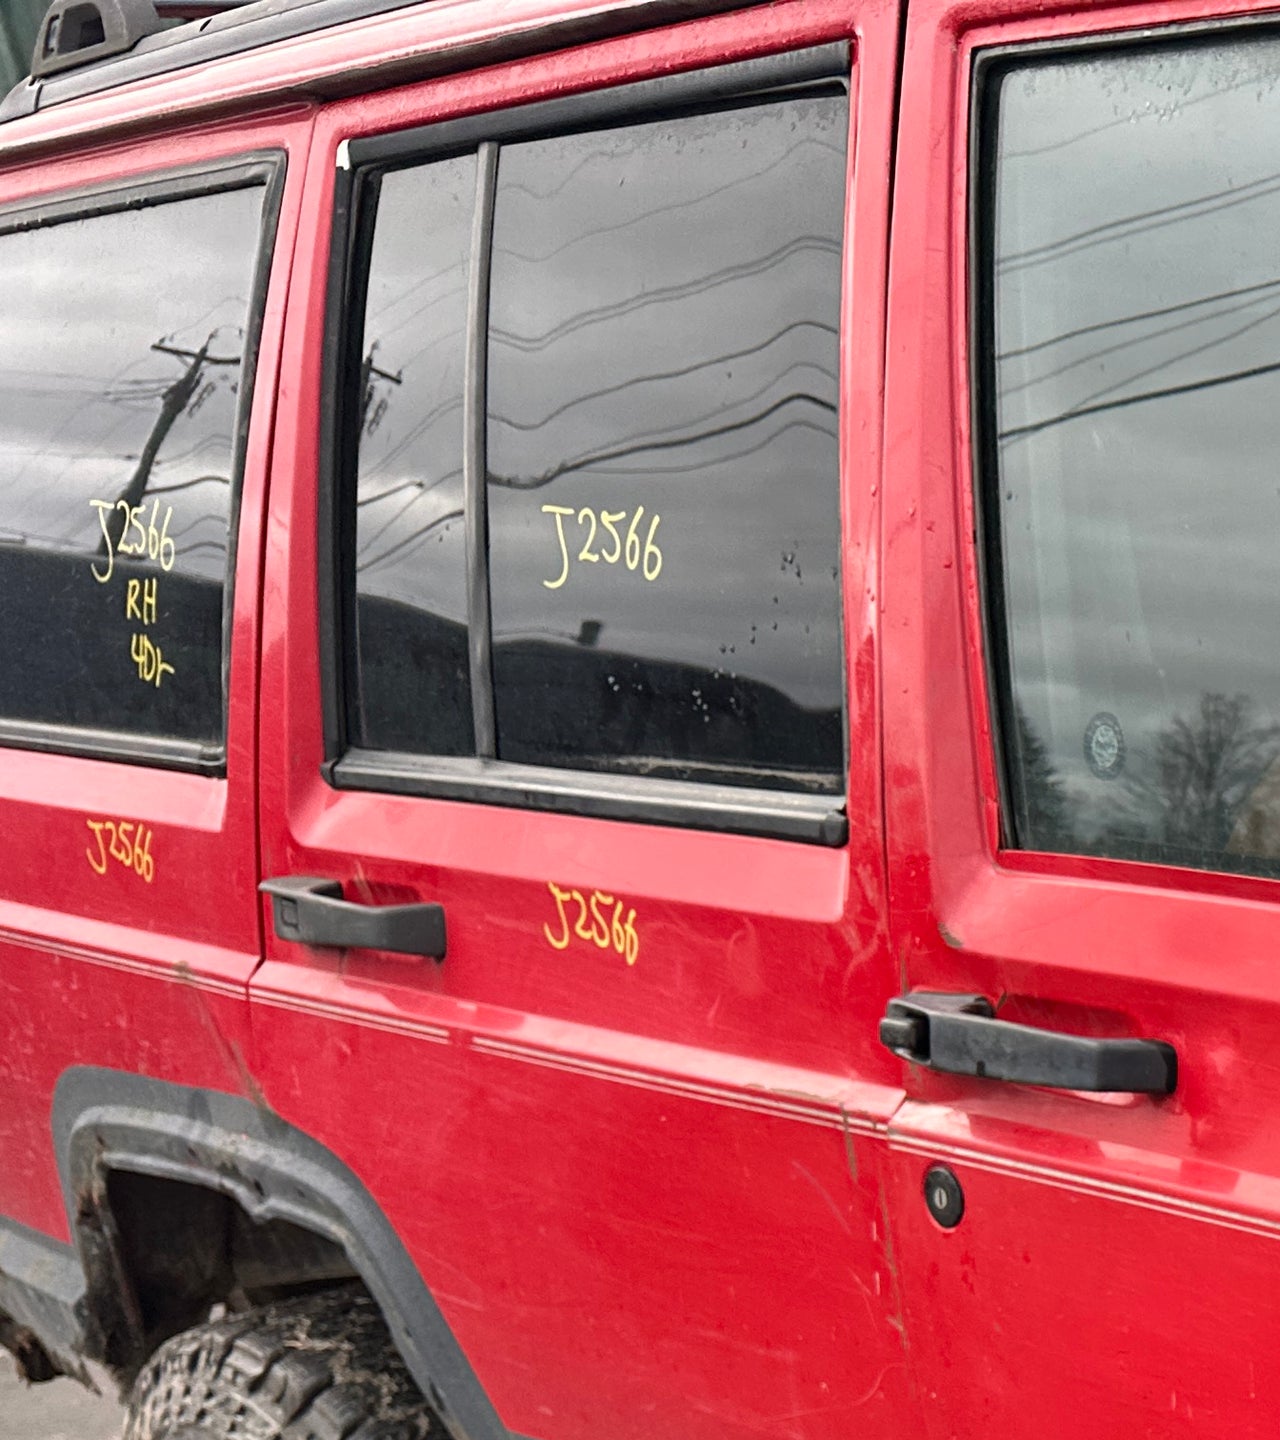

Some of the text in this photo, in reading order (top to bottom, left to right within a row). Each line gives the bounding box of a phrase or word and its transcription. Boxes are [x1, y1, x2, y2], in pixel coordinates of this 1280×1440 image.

[88, 497, 175, 583] J2566
[541, 505, 663, 590] J2566
[126, 577, 157, 626] RH
[86, 818, 154, 884] J2566
[544, 880, 640, 967] J2566
